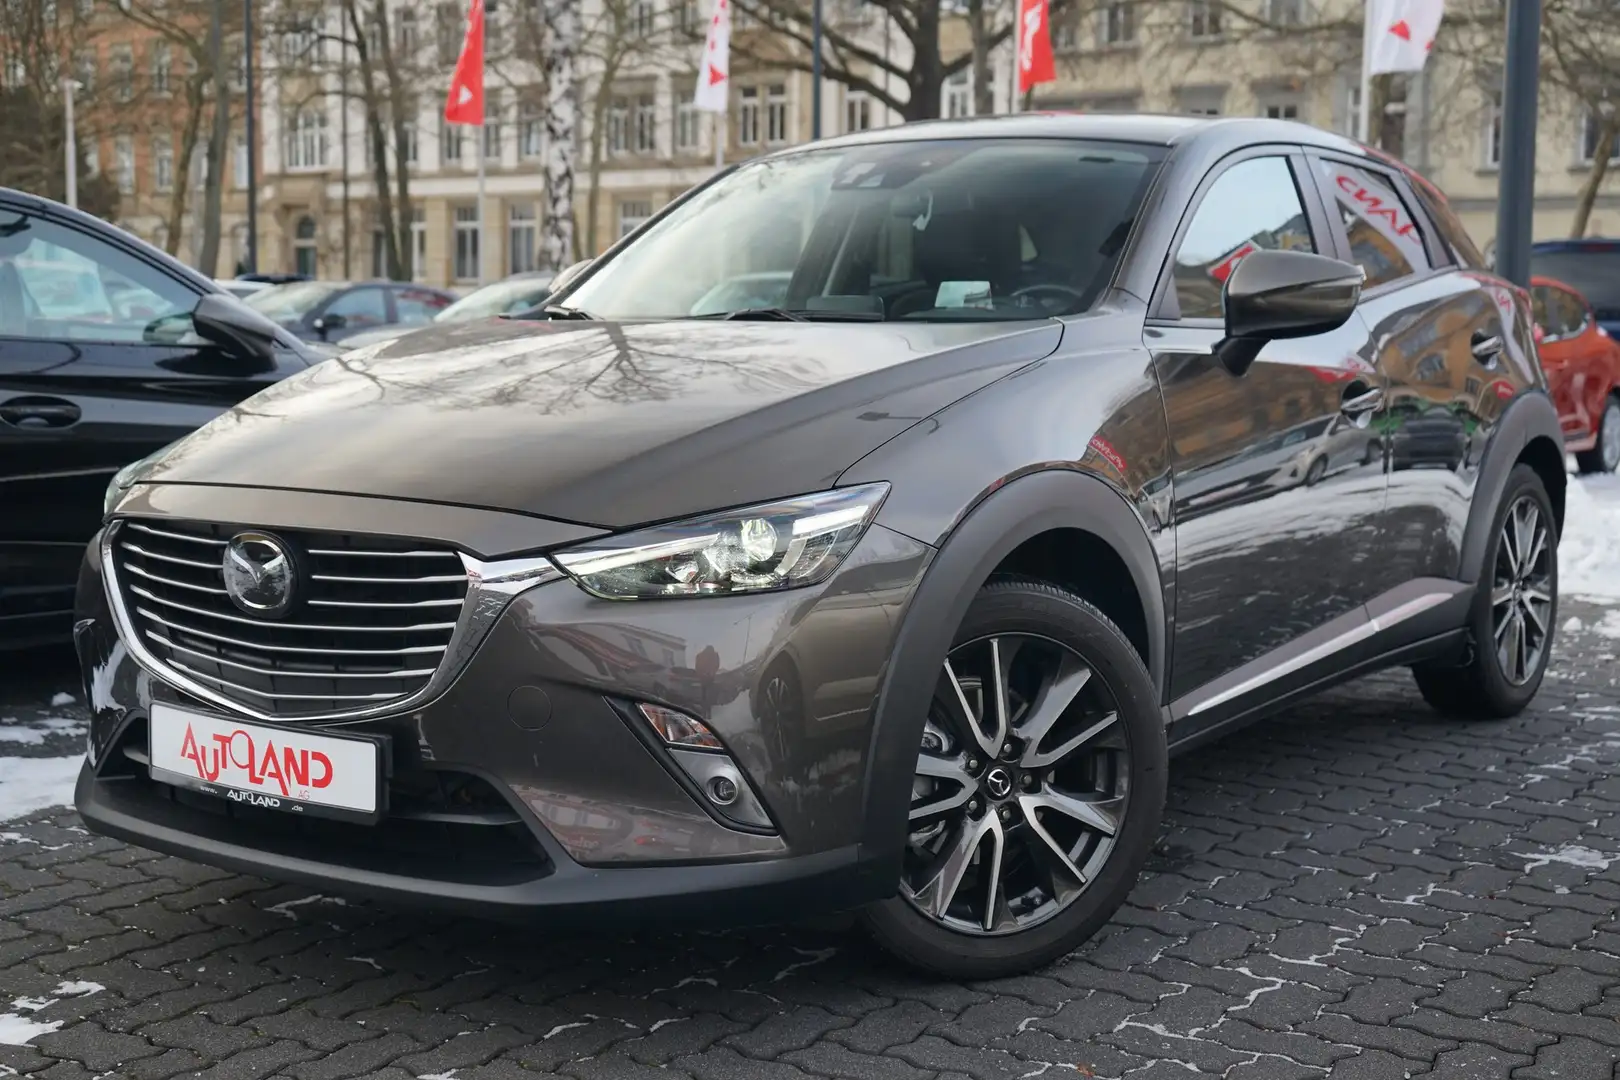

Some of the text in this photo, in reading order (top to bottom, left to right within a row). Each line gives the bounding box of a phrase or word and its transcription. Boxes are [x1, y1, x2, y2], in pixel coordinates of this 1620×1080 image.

[180, 721, 334, 796] AUTOLAND
[227, 789, 280, 807] AUTOLAND
[292, 804, 303, 812] .de
